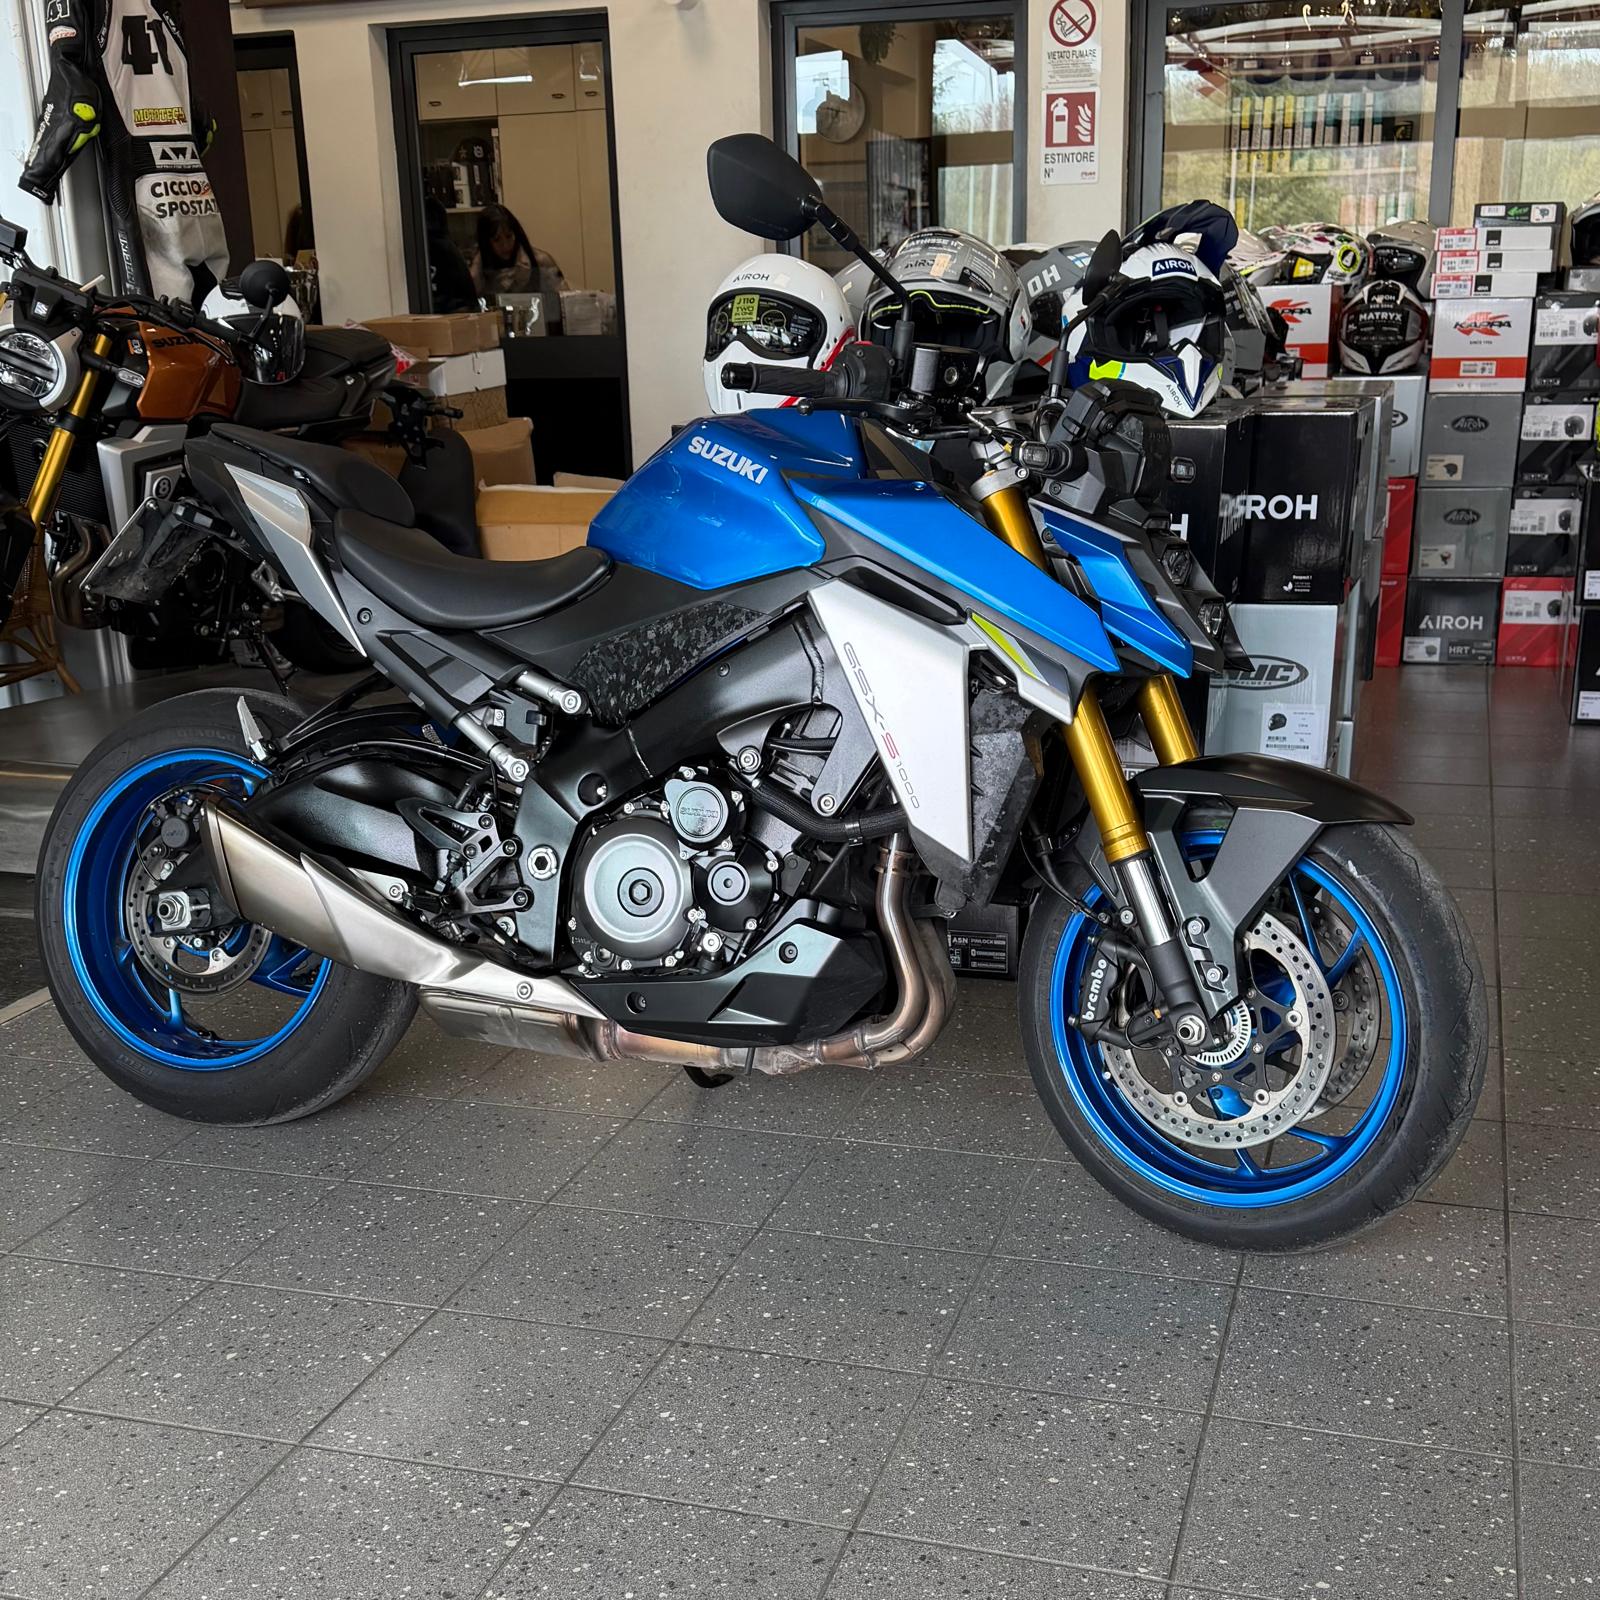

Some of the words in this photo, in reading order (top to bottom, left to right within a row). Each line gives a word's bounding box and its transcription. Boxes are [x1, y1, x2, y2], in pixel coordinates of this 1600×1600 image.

[122, 15, 173, 75] 41
[1047, 50, 1071, 60] VIETATO
[1044, 151, 1095, 164] ESTINTORE
[150, 180, 201, 198] CICCIO
[904, 258, 935, 268] AIRO
[1154, 259, 1195, 272] AIROH
[733, 273, 769, 282] AIROH
[1359, 311, 1402, 321] MATRYX
[1453, 320, 1512, 329] KAPPA
[1166, 384, 1182, 408] AIROH
[688, 436, 769, 485] SUZUKI
[159, 479, 170, 495] 8
[1246, 494, 1319, 520] ROH
[1419, 615, 1483, 630] AIROH
[1082, 958, 1107, 1021] brembo
